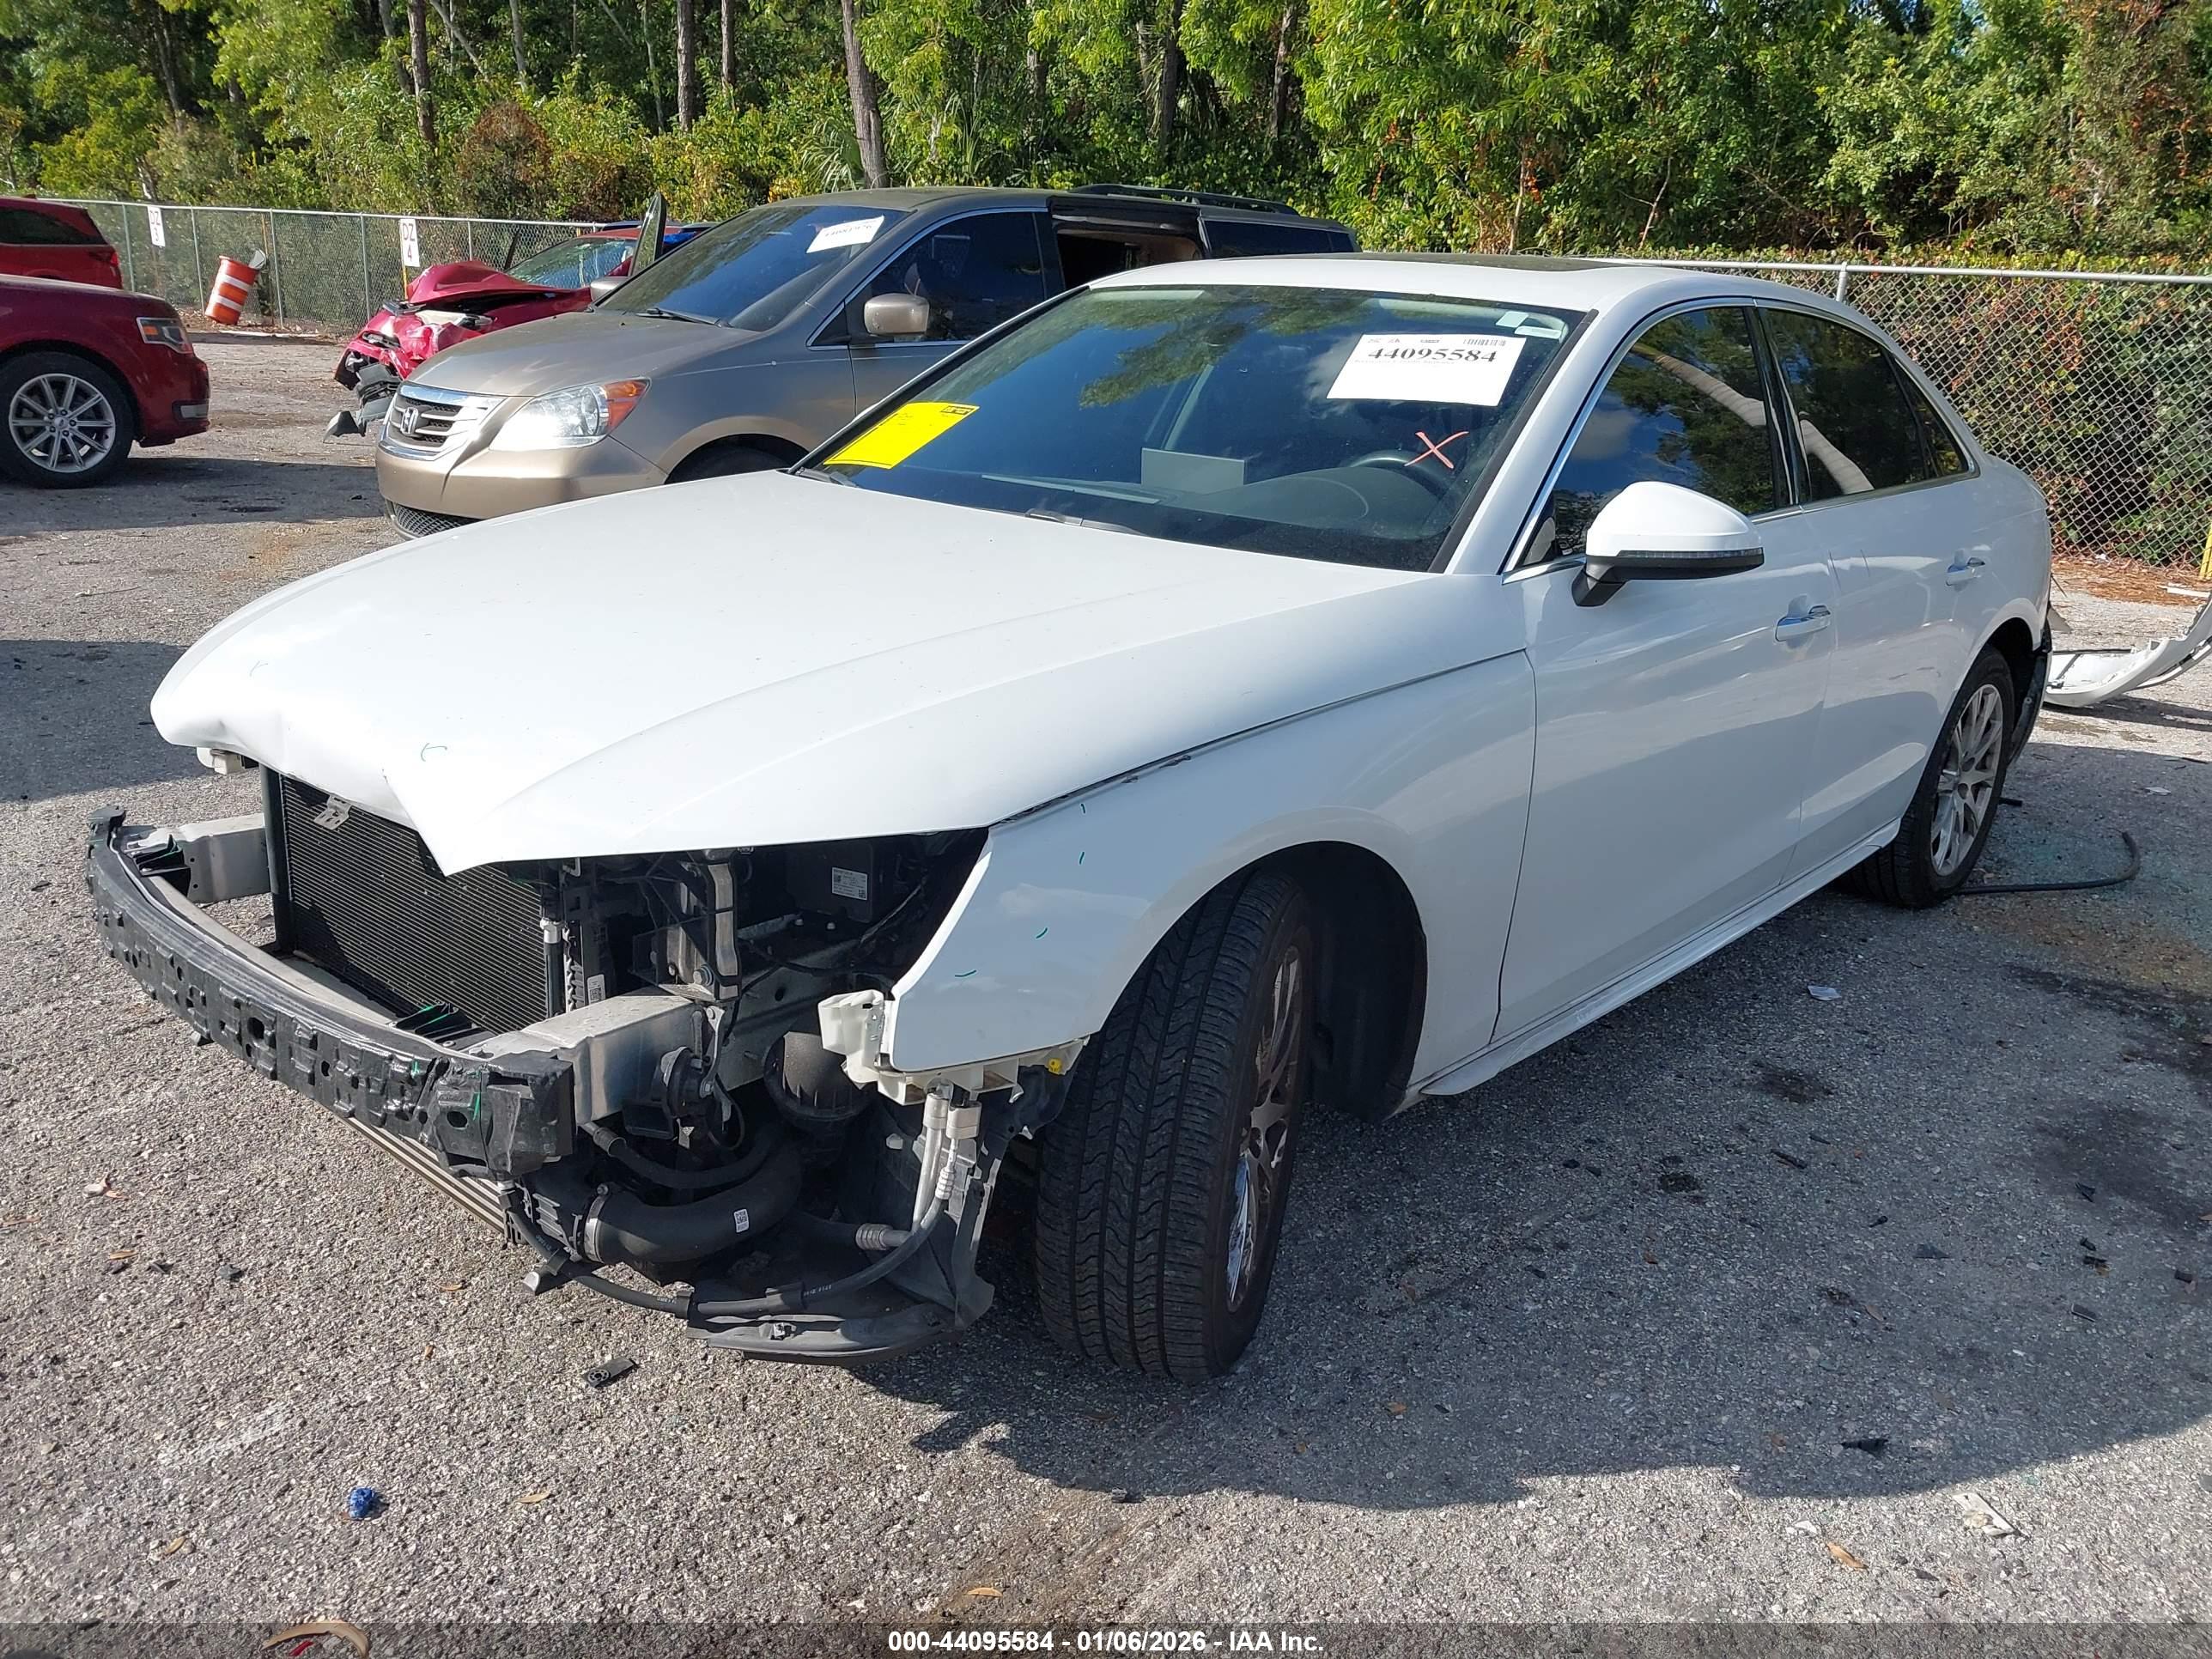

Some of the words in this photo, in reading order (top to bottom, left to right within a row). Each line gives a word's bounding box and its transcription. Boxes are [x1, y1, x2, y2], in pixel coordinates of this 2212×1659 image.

[403, 222, 415, 241] DZ
[407, 244, 412, 262] 4
[1368, 348, 1498, 362] 44095584
